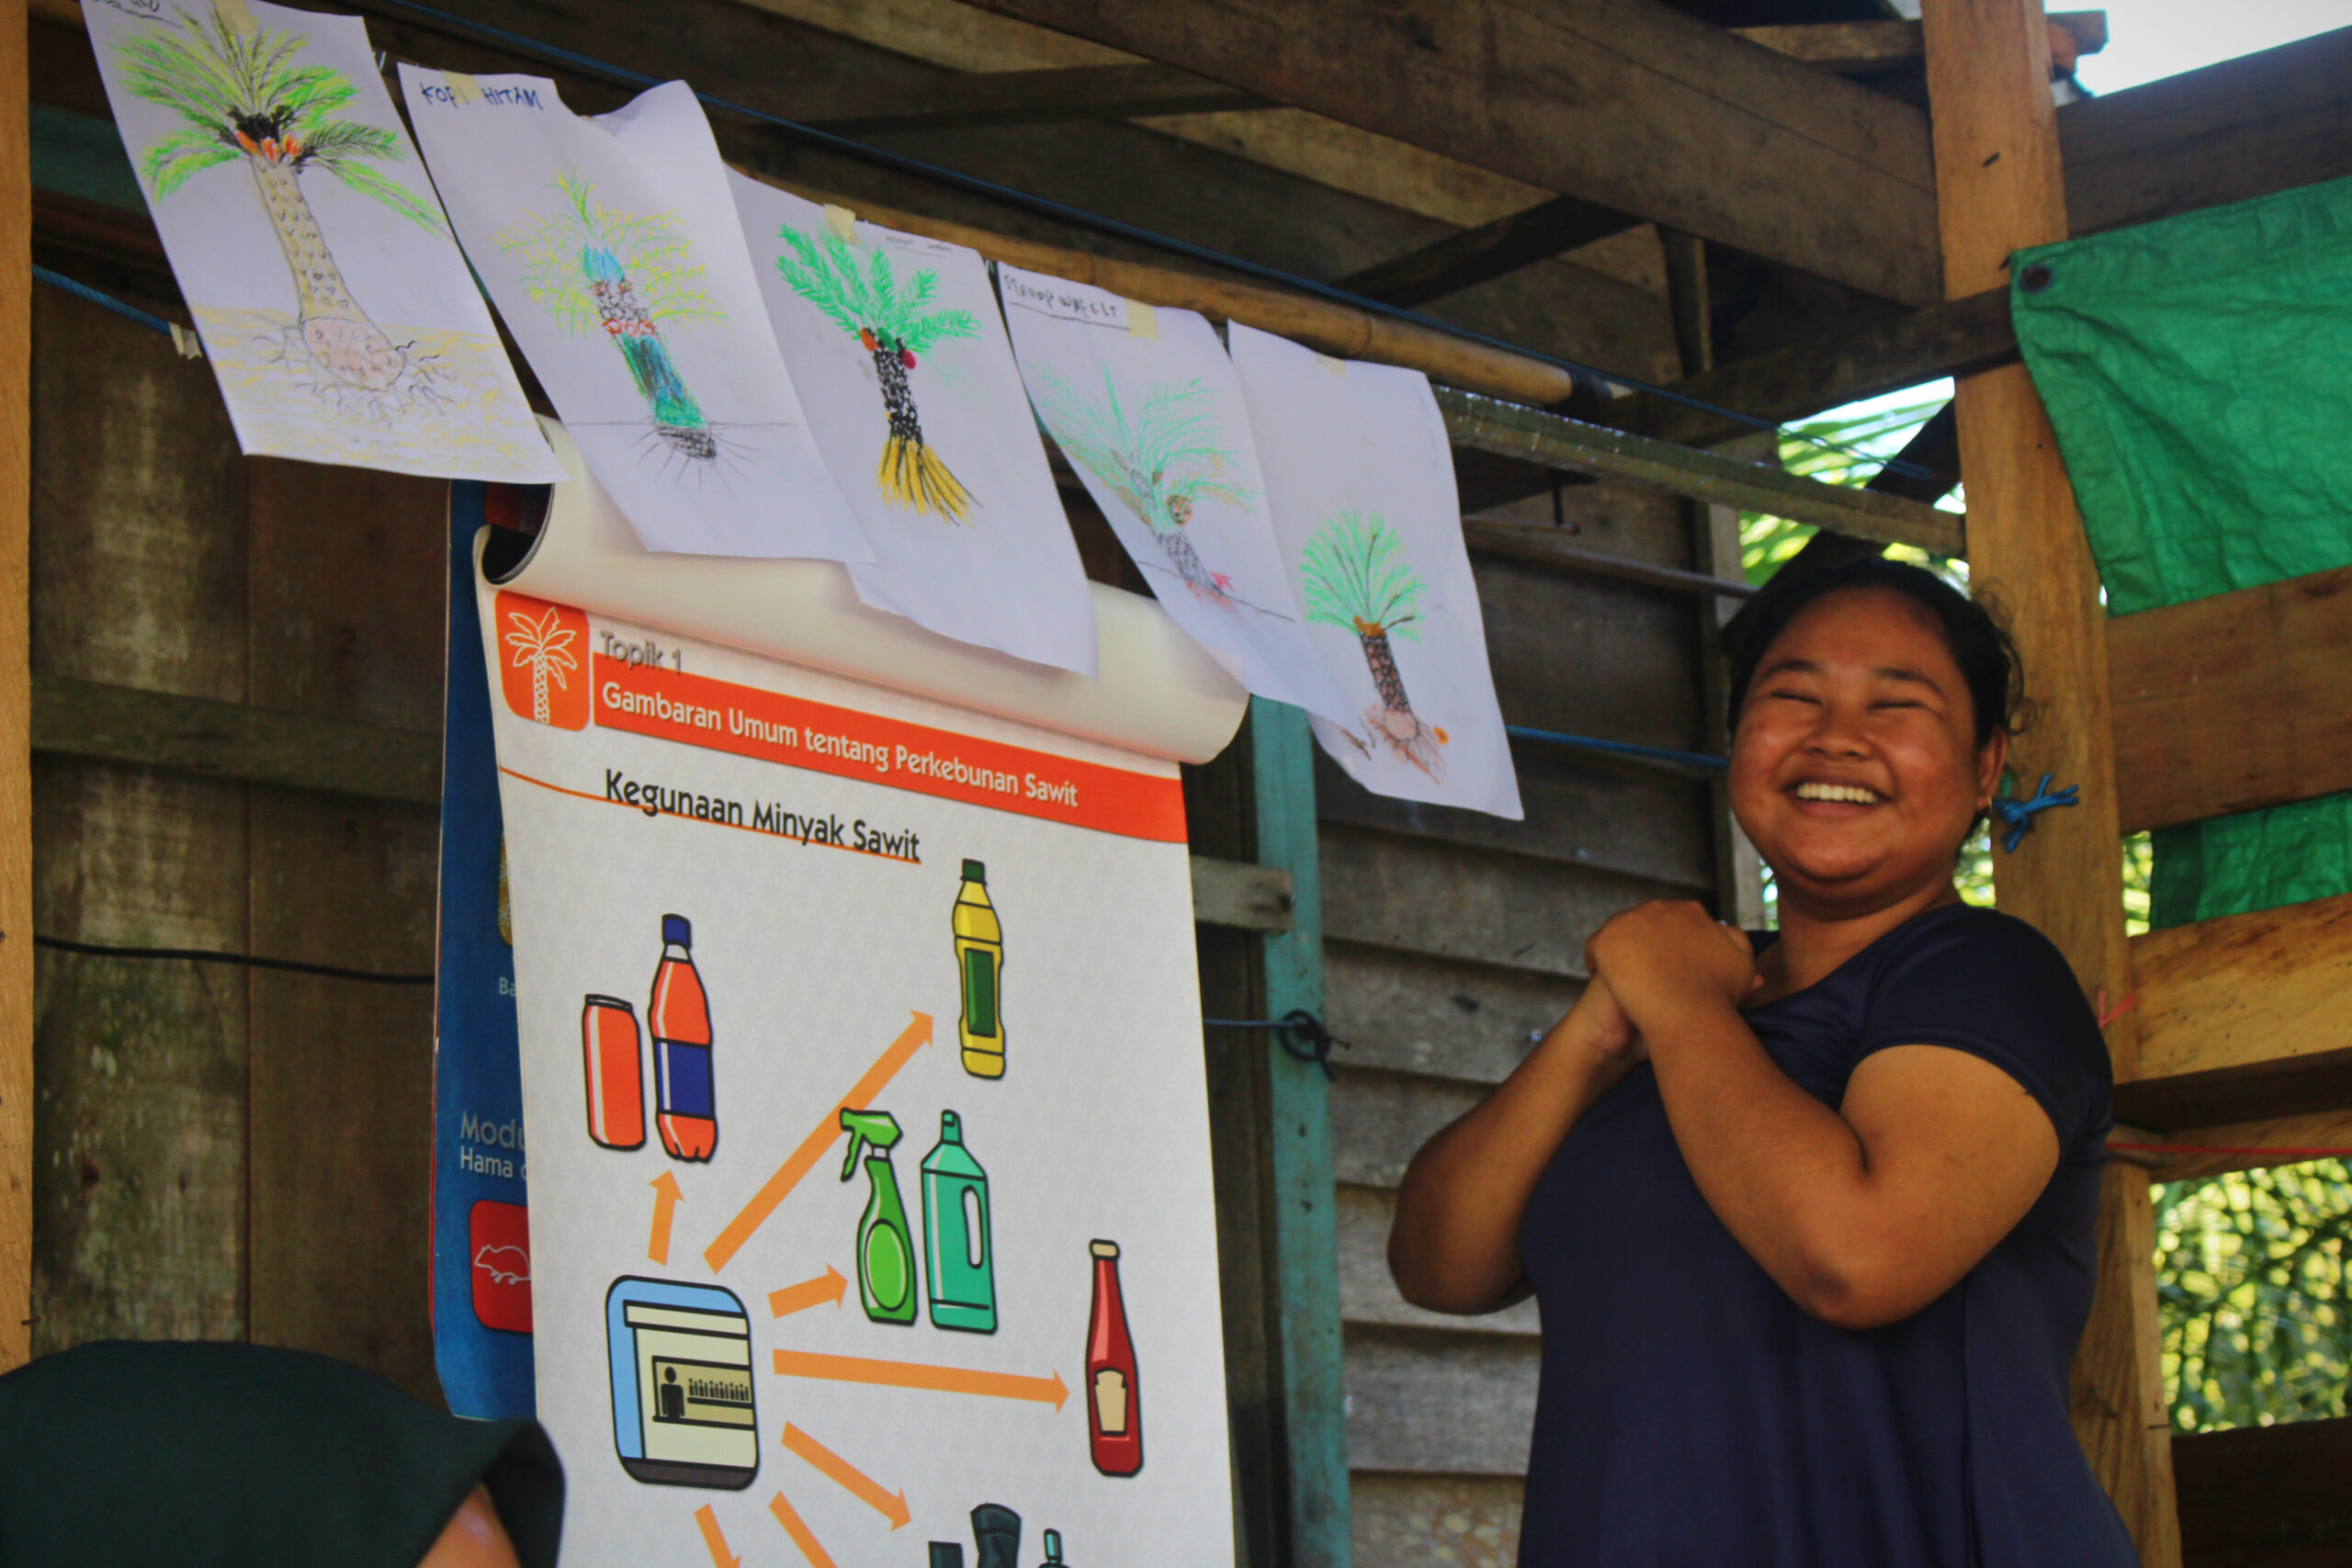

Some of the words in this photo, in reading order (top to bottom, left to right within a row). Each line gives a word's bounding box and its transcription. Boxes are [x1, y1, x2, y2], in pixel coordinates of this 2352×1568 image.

[481, 85, 545, 111] HITAM
[599, 629, 664, 671] Topik
[671, 648, 682, 675] 1
[602, 681, 722, 731] Gambaran
[728, 707, 798, 748] Umum
[804, 727, 889, 773] tentang
[896, 745, 1020, 795] Perkebunan
[1024, 773, 1079, 808] Sawit
[605, 768, 744, 826] Kegunaan
[752, 799, 845, 847] Minyak
[853, 819, 921, 863] Sawit
[460, 1145, 514, 1179] Hama
